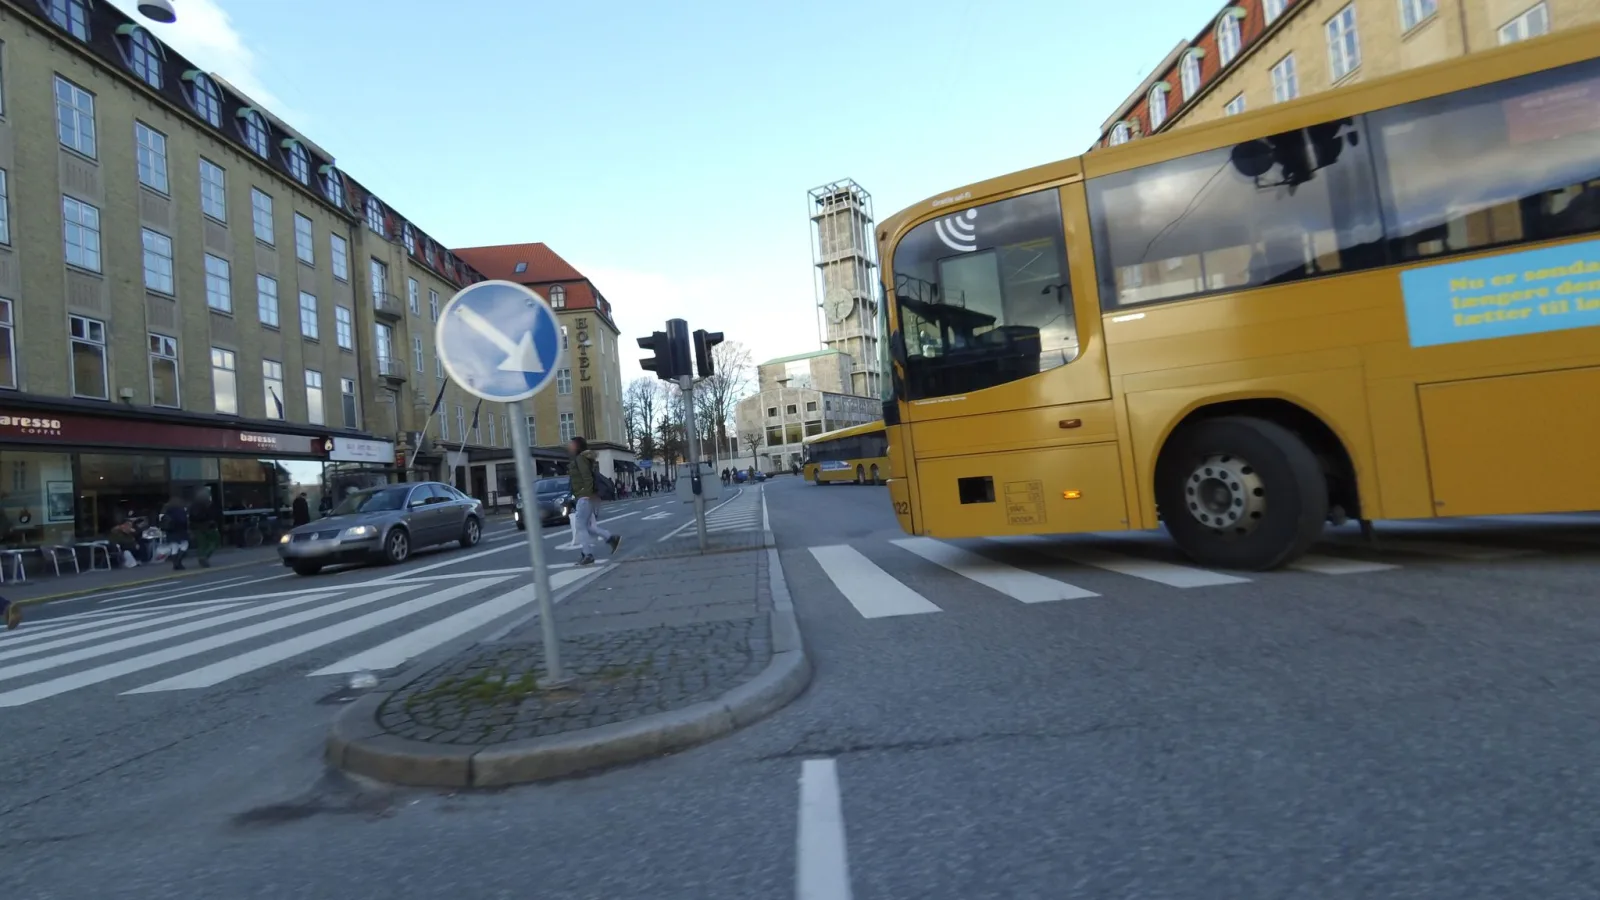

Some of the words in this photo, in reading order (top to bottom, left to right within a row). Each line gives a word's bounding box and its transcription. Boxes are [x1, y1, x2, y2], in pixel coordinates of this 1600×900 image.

[1450, 277, 1485, 291] Nu
[1491, 273, 1517, 286] er
[575, 318, 591, 381] HOTEL
